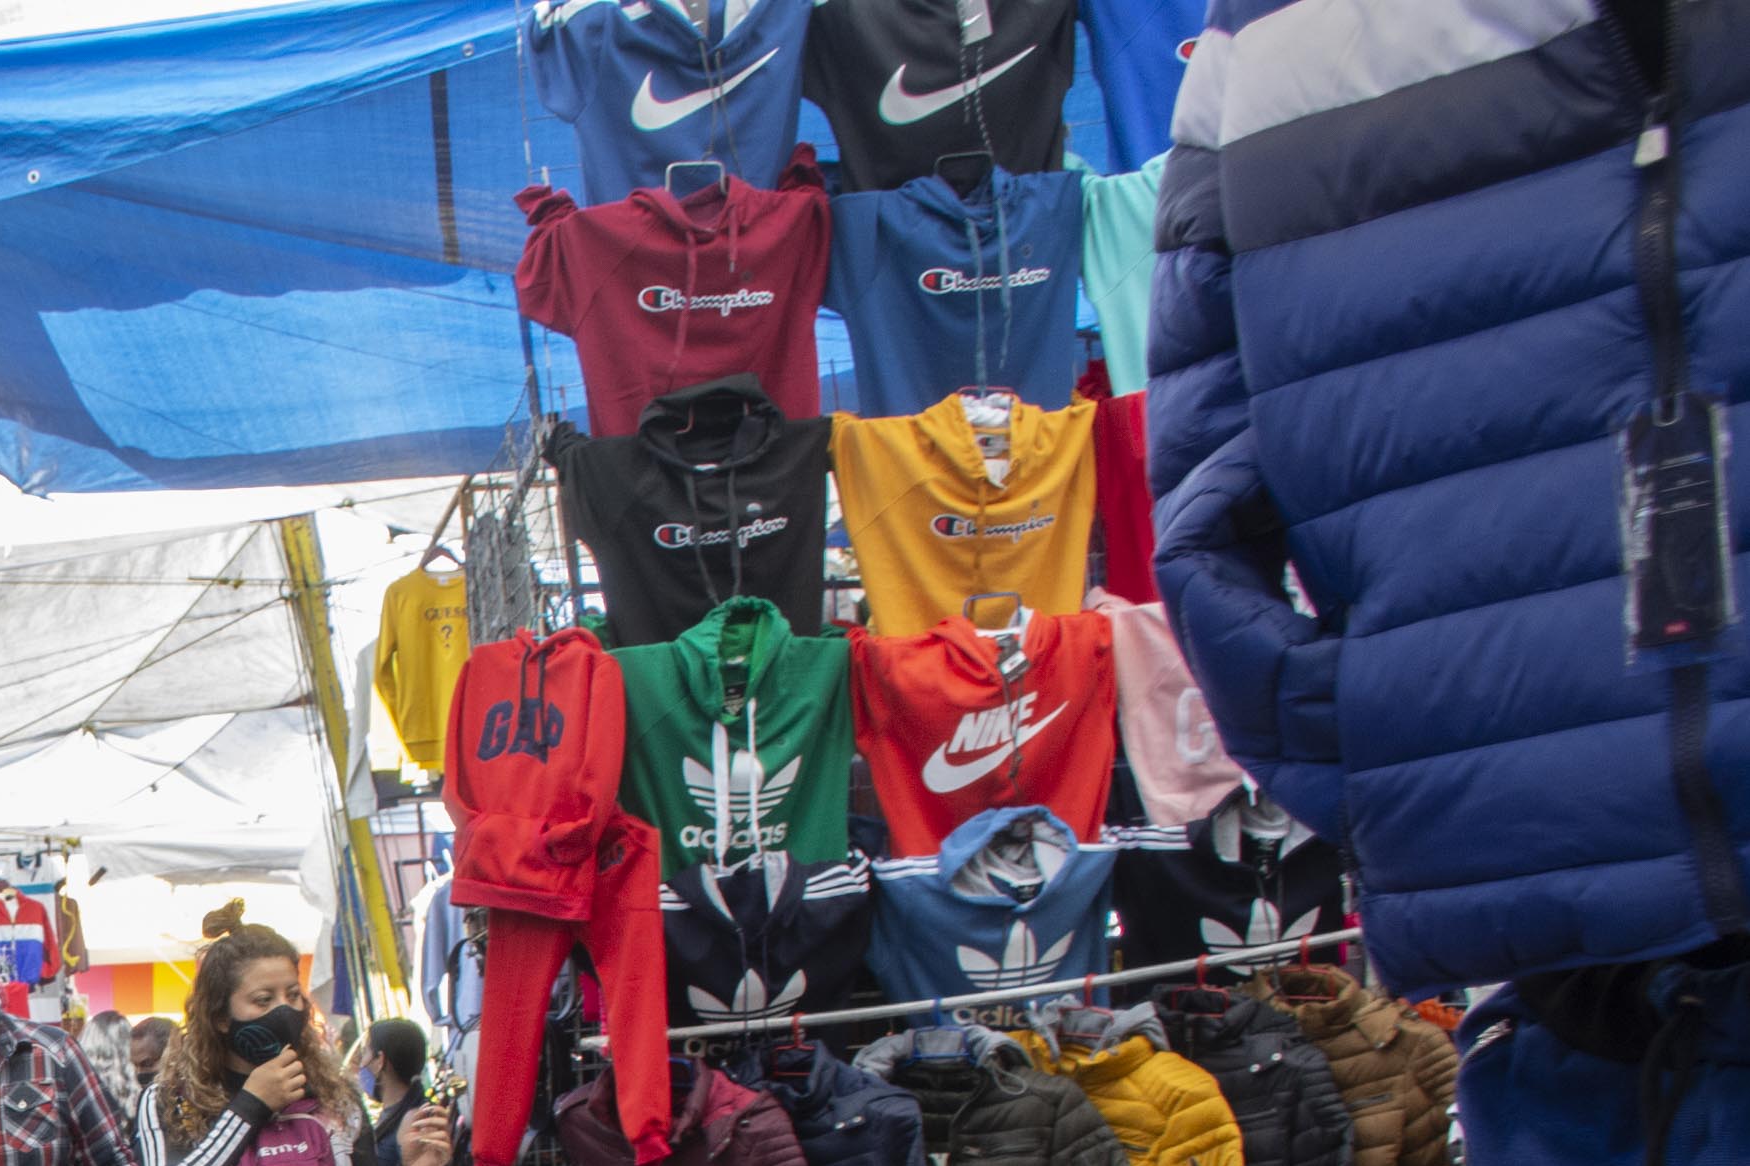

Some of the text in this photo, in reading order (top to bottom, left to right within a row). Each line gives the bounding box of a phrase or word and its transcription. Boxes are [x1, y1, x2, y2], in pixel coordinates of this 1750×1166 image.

[918, 267, 1050, 295] Chamion
[477, 697, 565, 765] GAP
[947, 691, 1039, 753] NIKE
[680, 822, 788, 850] addas
[952, 1004, 1030, 1026] adi
